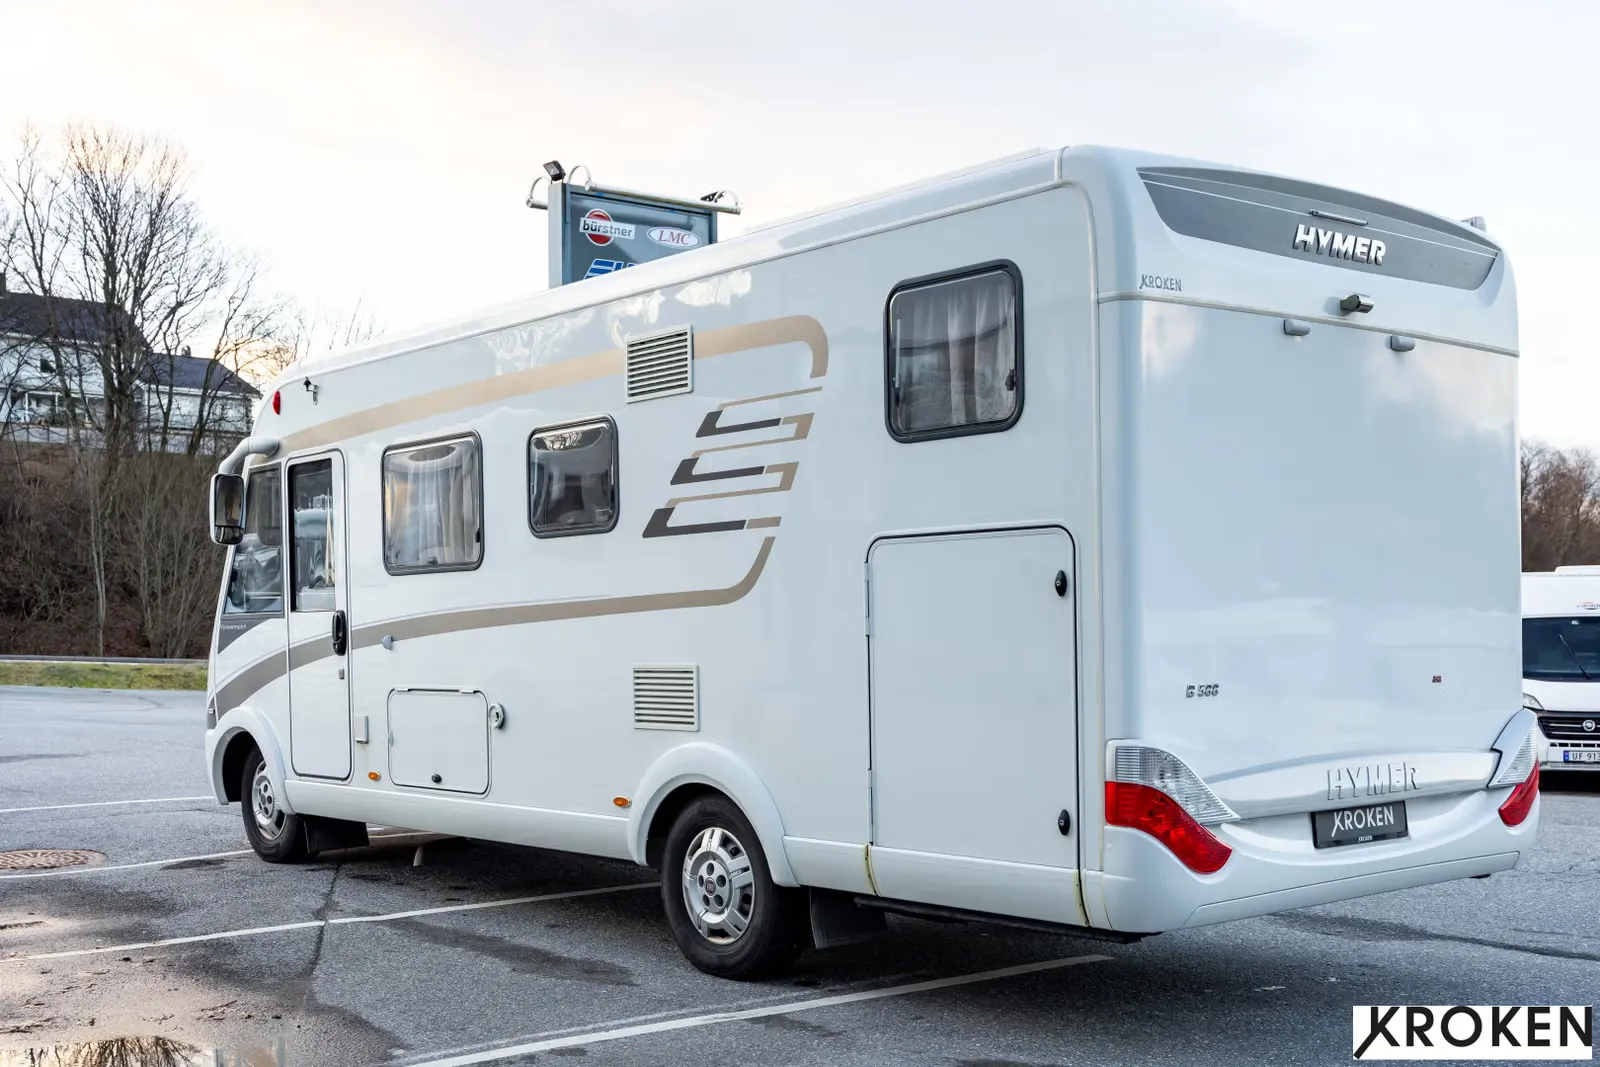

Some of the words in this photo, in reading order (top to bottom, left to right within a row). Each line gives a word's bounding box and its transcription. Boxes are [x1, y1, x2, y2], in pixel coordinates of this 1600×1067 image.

[582, 219, 633, 238] bürstner
[658, 229, 691, 245] LMC
[1292, 223, 1387, 267] HYMER
[1139, 274, 1182, 291] KROKEN
[1572, 752, 1583, 760] UF
[1327, 761, 1421, 801] HYMER
[1331, 805, 1395, 838] KROKEN
